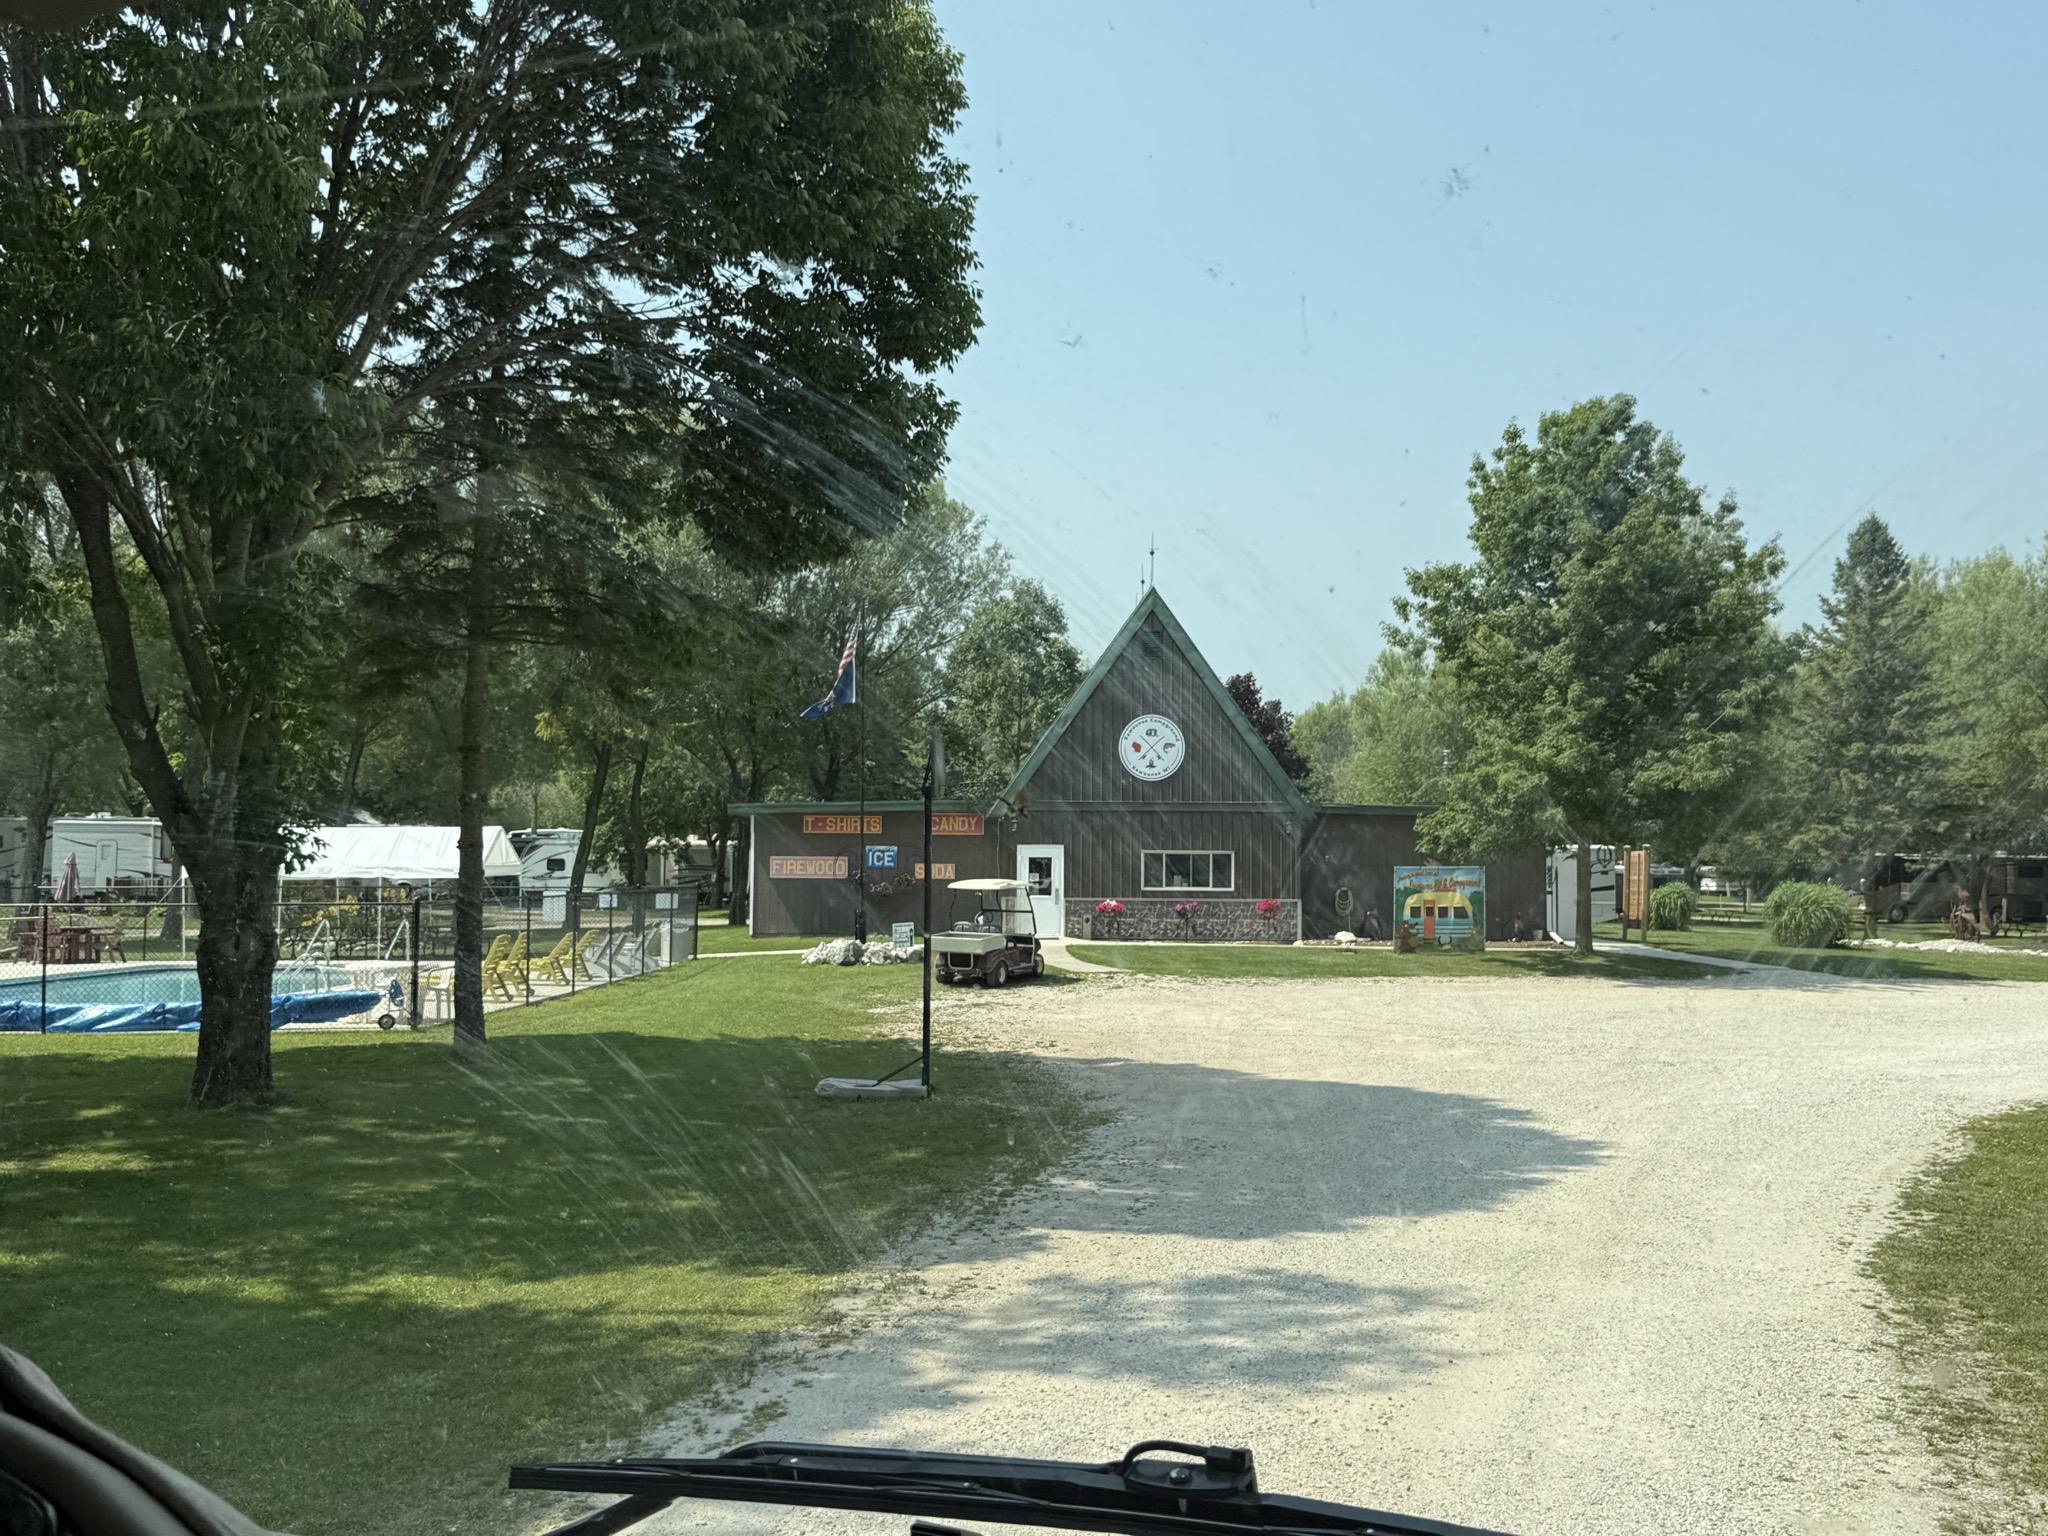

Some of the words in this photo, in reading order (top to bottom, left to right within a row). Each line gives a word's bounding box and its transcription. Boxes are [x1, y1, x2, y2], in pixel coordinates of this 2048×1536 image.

[1149, 718, 1180, 742] Campground
[932, 816, 979, 832] CANDY
[772, 859, 845, 875] FIREWOOD
[868, 851, 894, 867] ICE
[916, 864, 954, 879] SDA
